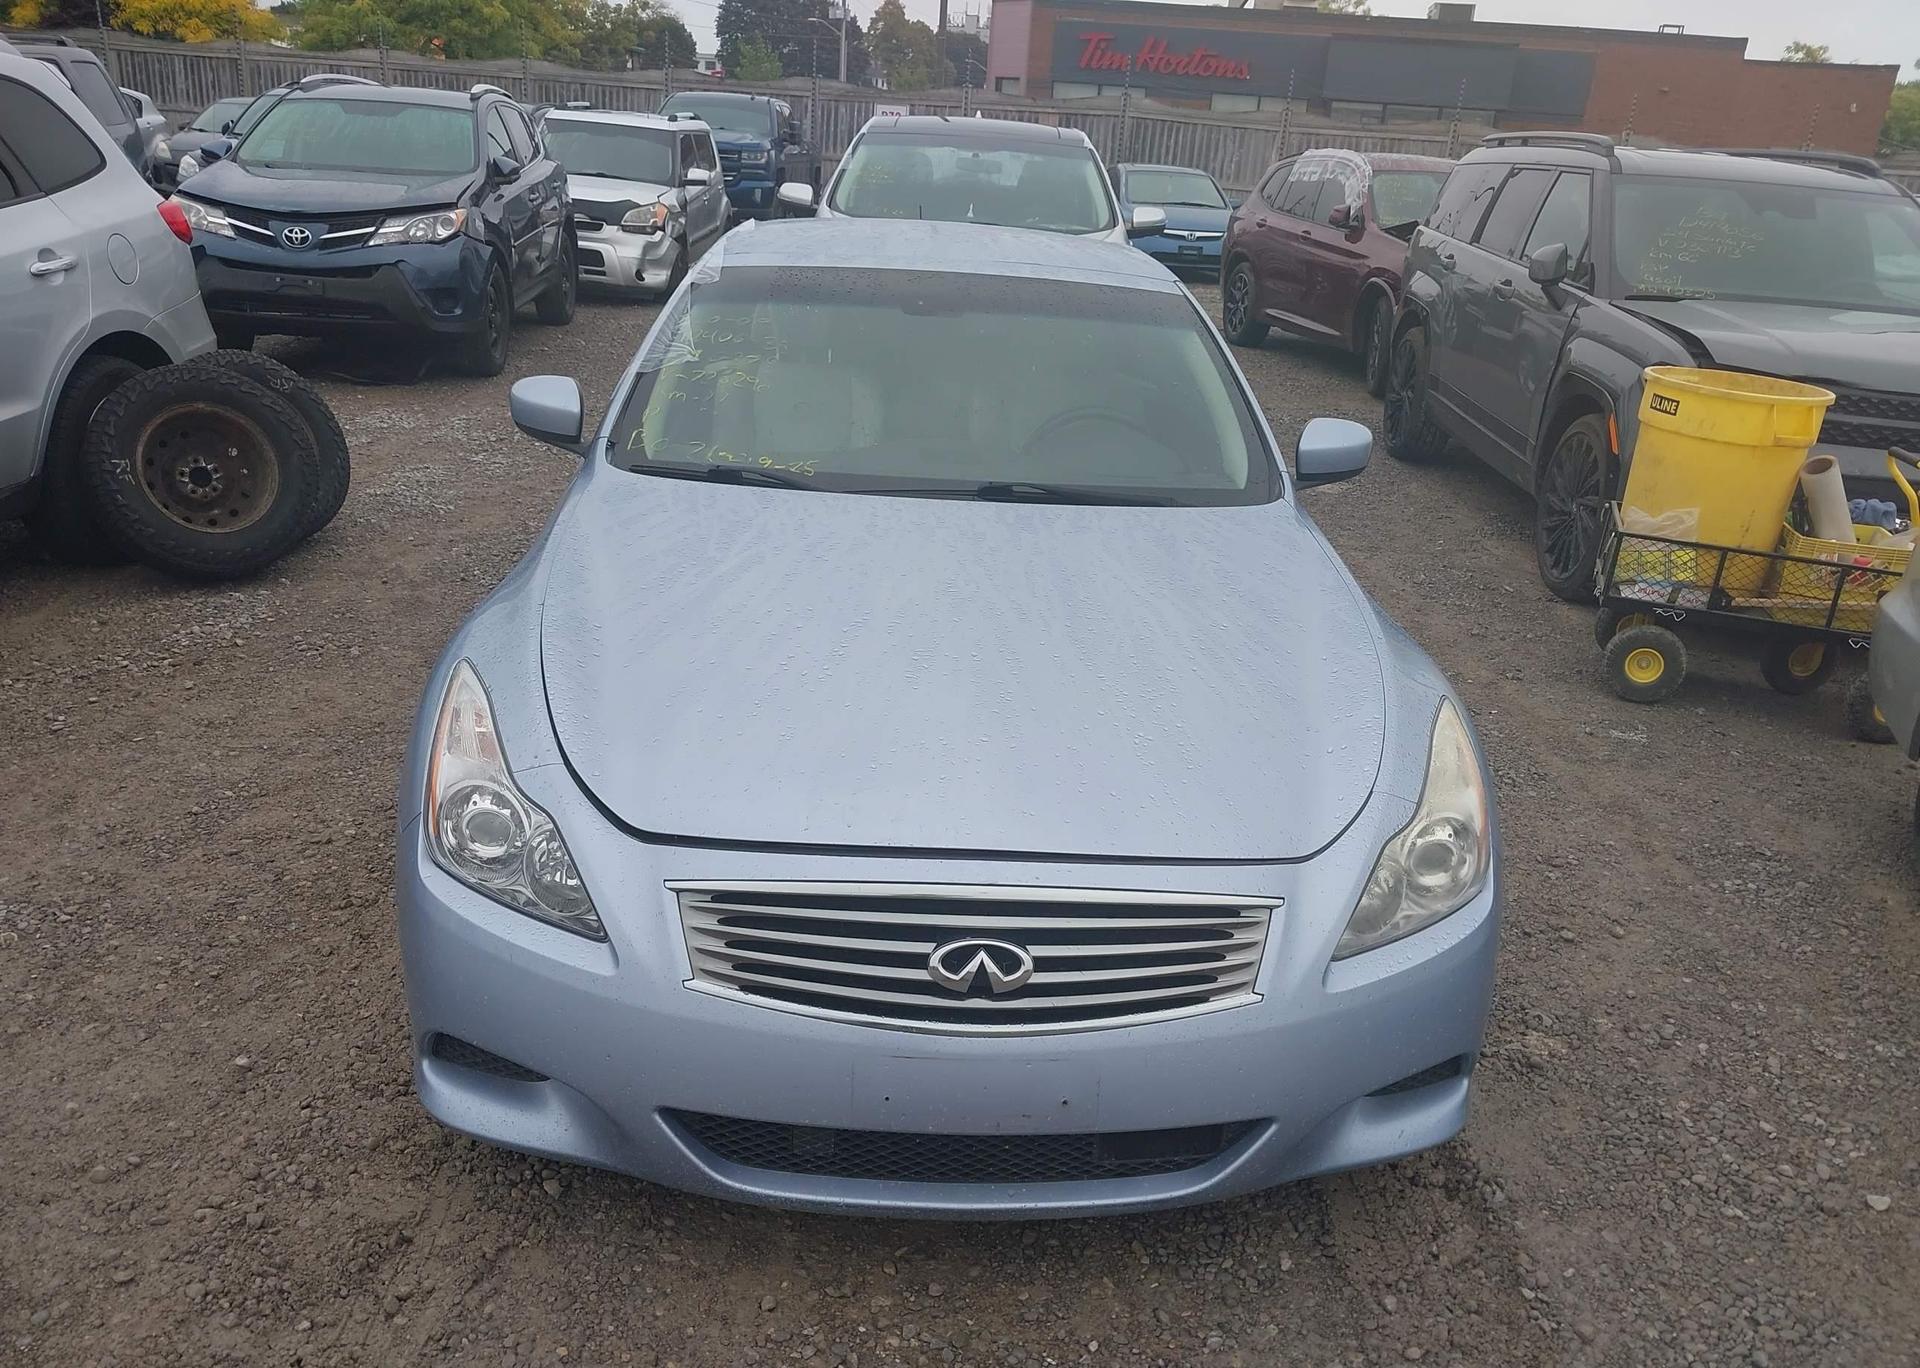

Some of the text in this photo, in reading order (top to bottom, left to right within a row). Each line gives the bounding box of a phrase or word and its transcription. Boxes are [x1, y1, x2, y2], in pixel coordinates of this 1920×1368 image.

[1079, 31, 1250, 80] Tim Hortons
[1651, 395, 1678, 414] ULINE
